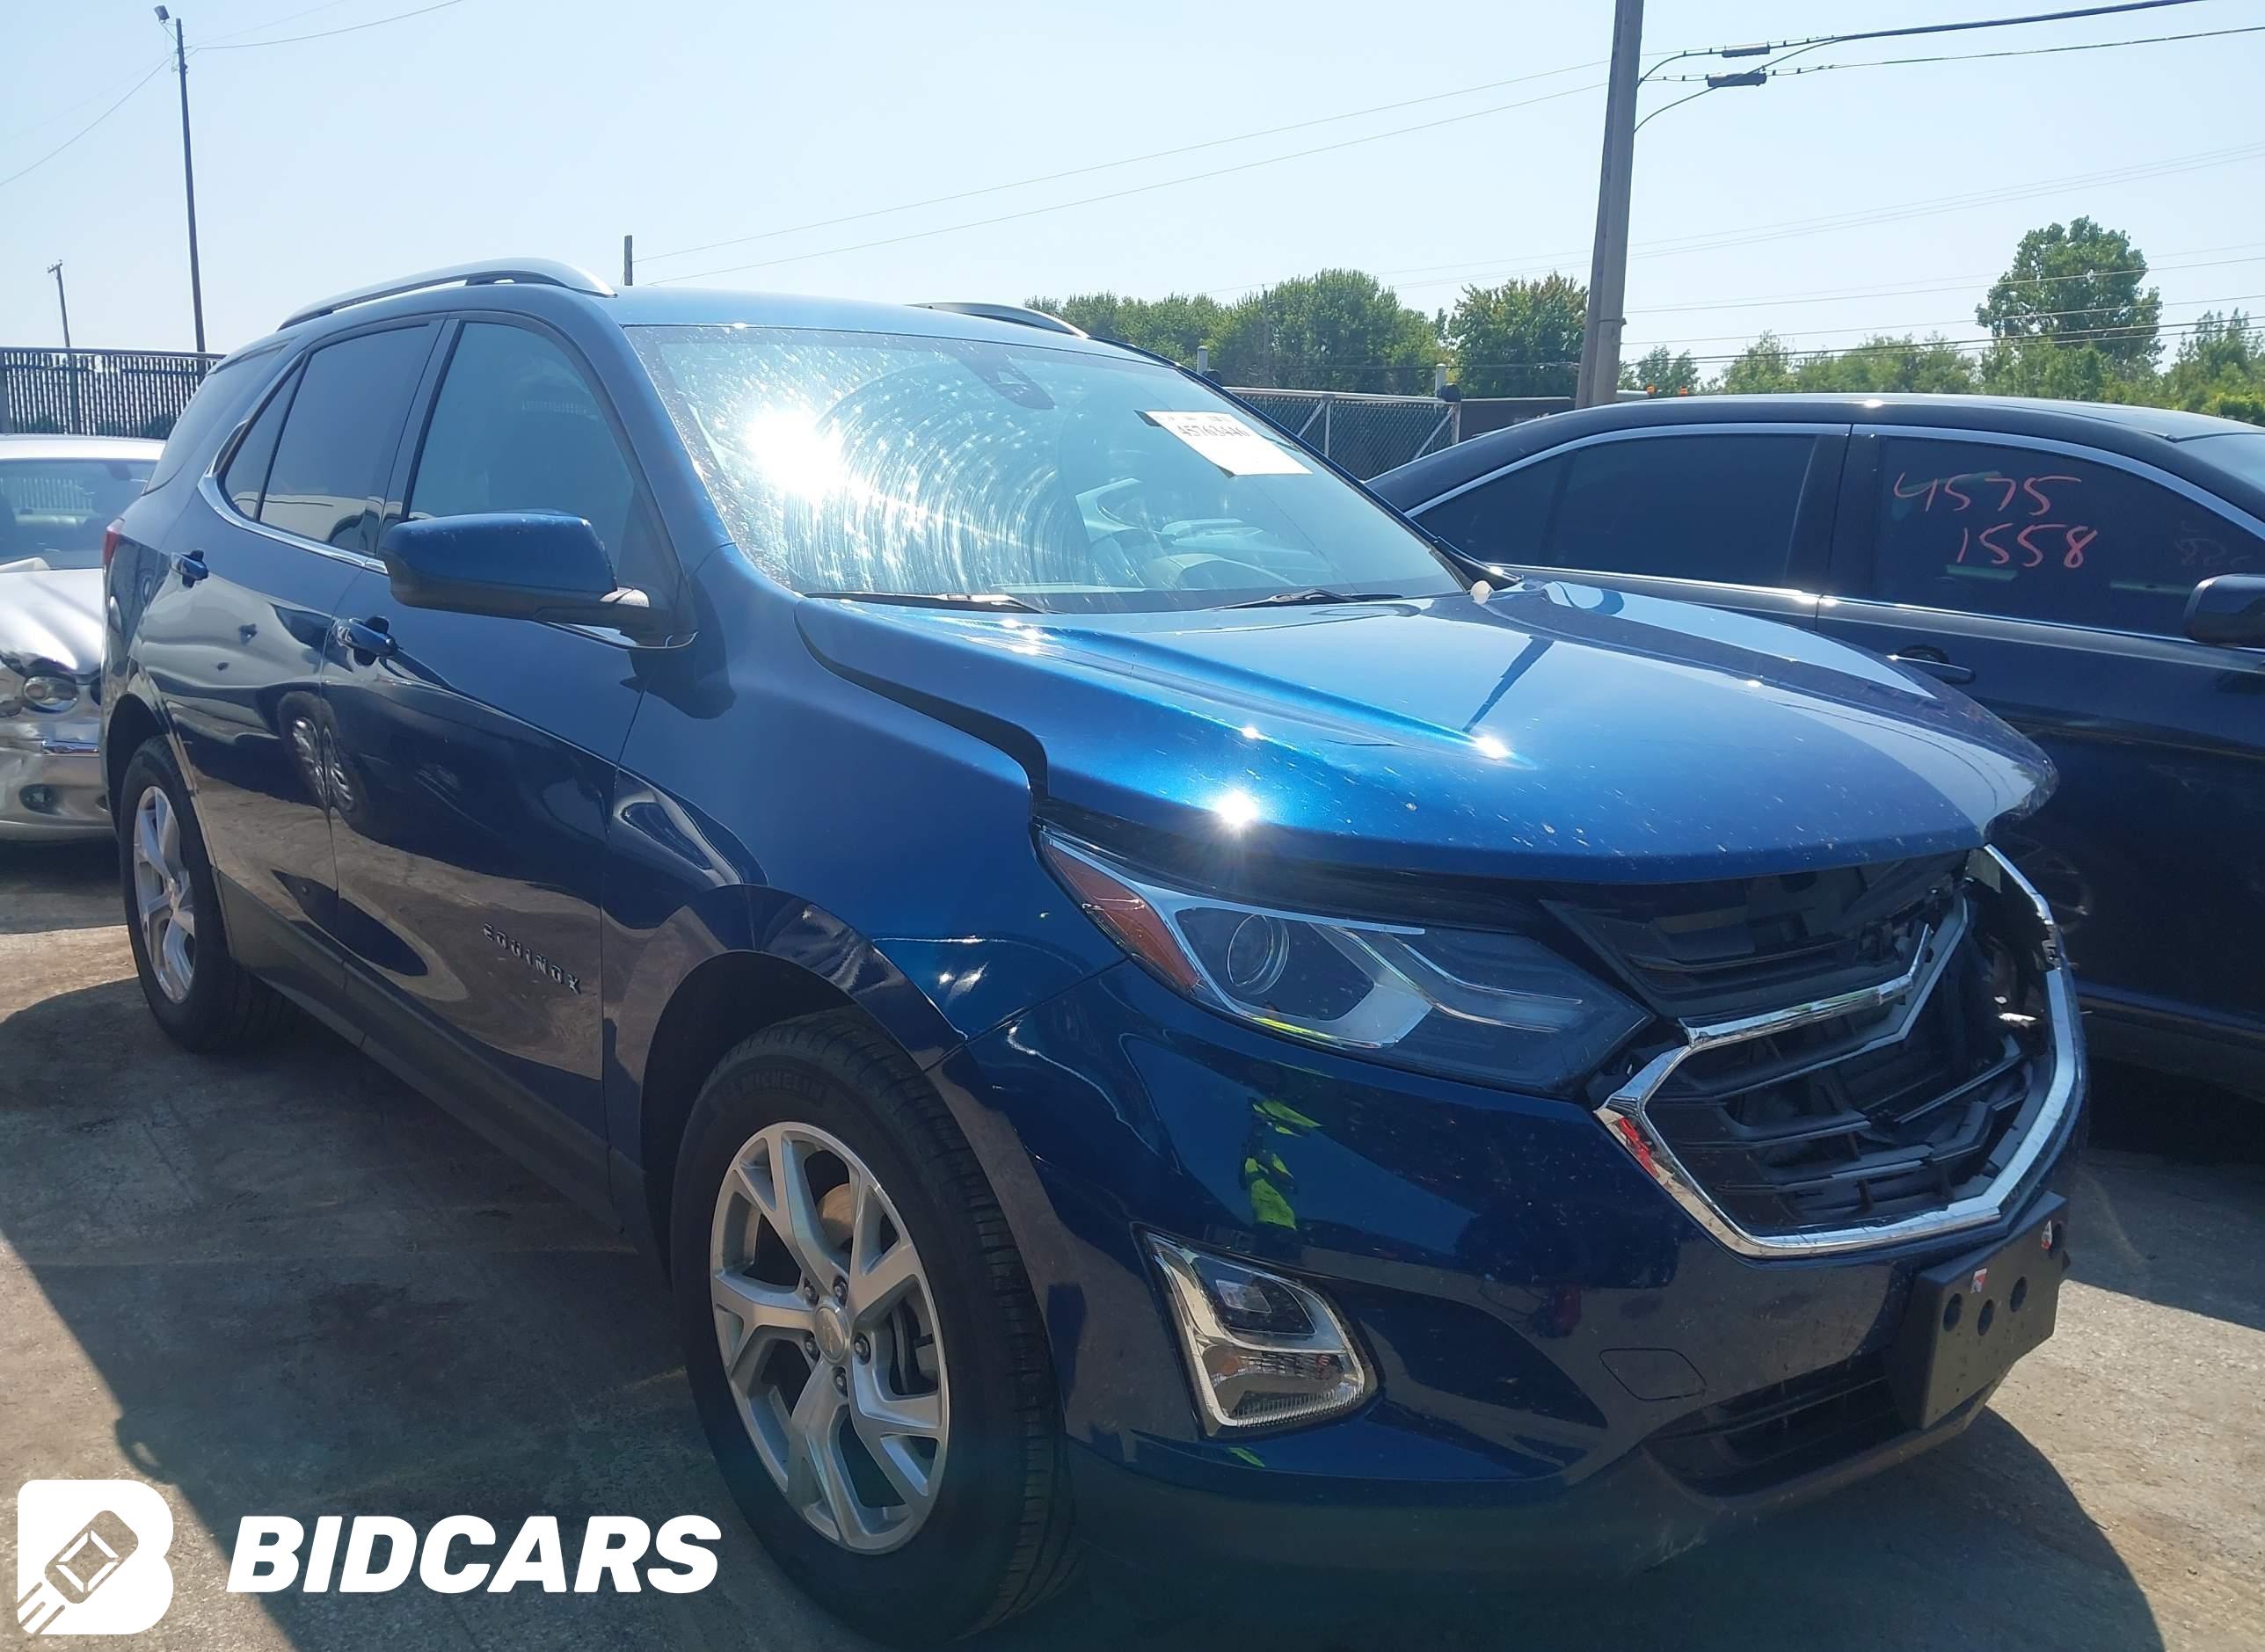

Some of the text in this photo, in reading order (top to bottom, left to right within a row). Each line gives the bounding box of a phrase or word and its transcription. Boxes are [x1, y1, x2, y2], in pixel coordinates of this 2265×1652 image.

[1892, 471, 2082, 516] 4575
[1956, 522, 2098, 569] 1558
[483, 922, 581, 995] EQUINOX
